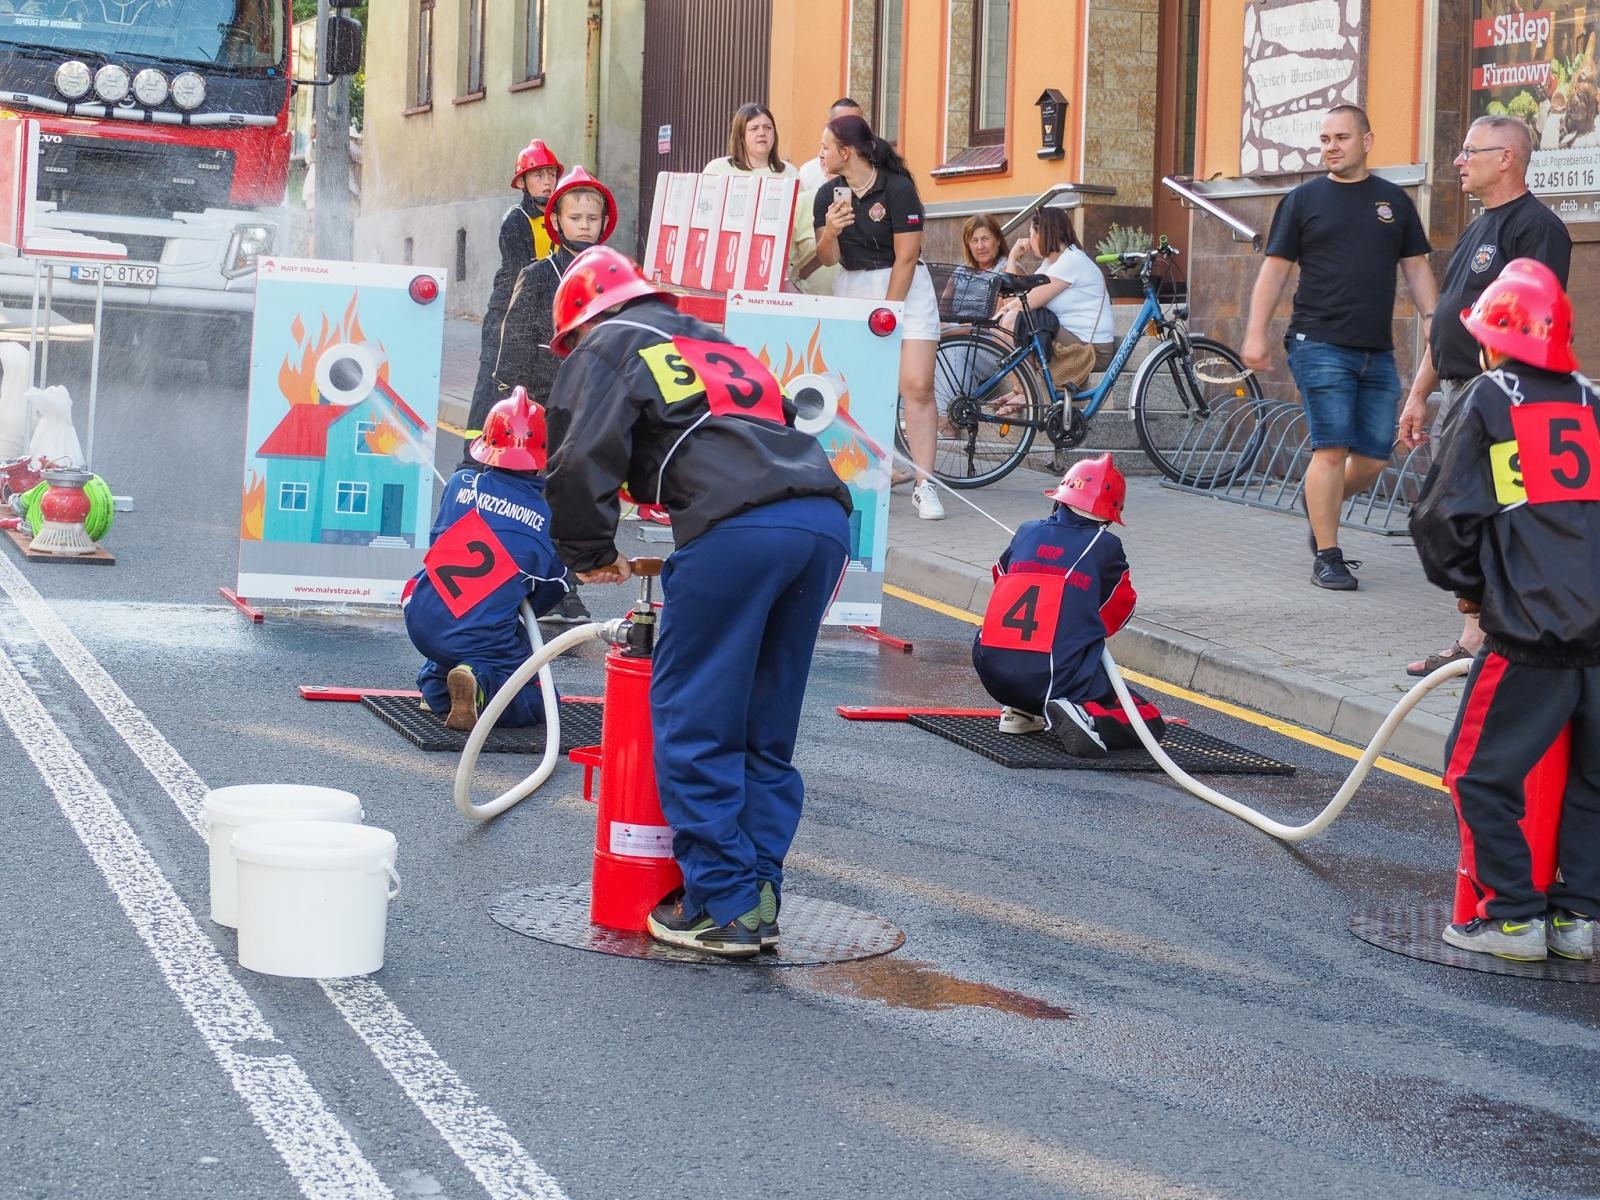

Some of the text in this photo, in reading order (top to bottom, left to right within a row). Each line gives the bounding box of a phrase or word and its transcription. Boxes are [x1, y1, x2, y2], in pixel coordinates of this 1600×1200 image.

[1494, 12, 1550, 48] Sklep
[1482, 63, 1551, 86] Firmowy
[1533, 169, 1594, 188] 32 451 61 16
[1560, 200, 1578, 212] drób
[665, 229, 677, 265] 6
[695, 232, 706, 268] 7
[725, 235, 737, 273] 8
[759, 239, 771, 278] 9
[117, 267, 155, 283] 8TK9
[705, 352, 763, 409] 3
[1548, 418, 1591, 489] 5
[456, 487, 545, 532] MDP KRZYŻANOWICE
[434, 540, 495, 600] 2
[294, 586, 371, 596] www.malystrazak.pl
[1001, 585, 1041, 642] 4
